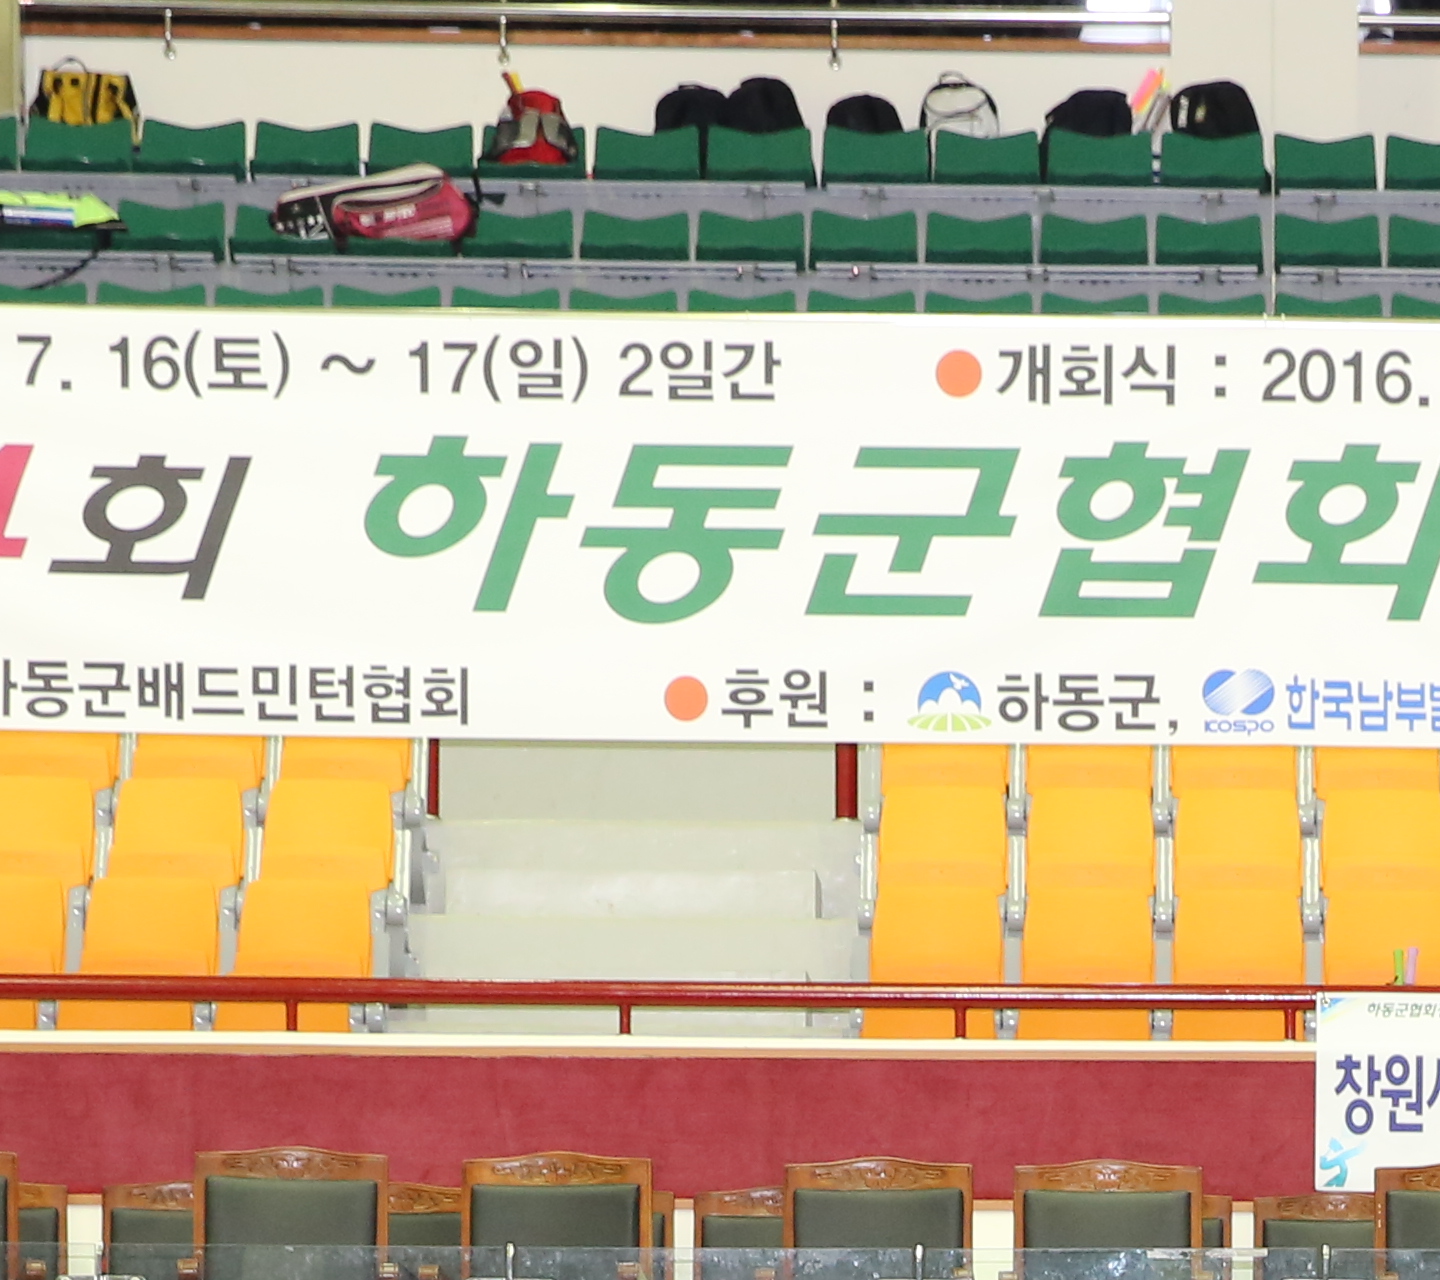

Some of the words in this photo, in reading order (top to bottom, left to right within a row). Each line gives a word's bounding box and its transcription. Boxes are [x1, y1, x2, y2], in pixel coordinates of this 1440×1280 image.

[17, 335, 71, 390] 7.
[110, 330, 289, 398] 16(토)
[409, 335, 587, 402] 17(일)
[619, 341, 781, 401] 2일간
[998, 344, 1175, 406] 개회식
[1263, 348, 1429, 407] 2016.
[722, 670, 827, 728] 후원
[998, 673, 1177, 734] 하동군,
[1204, 720, 1274, 736] KOSPO
